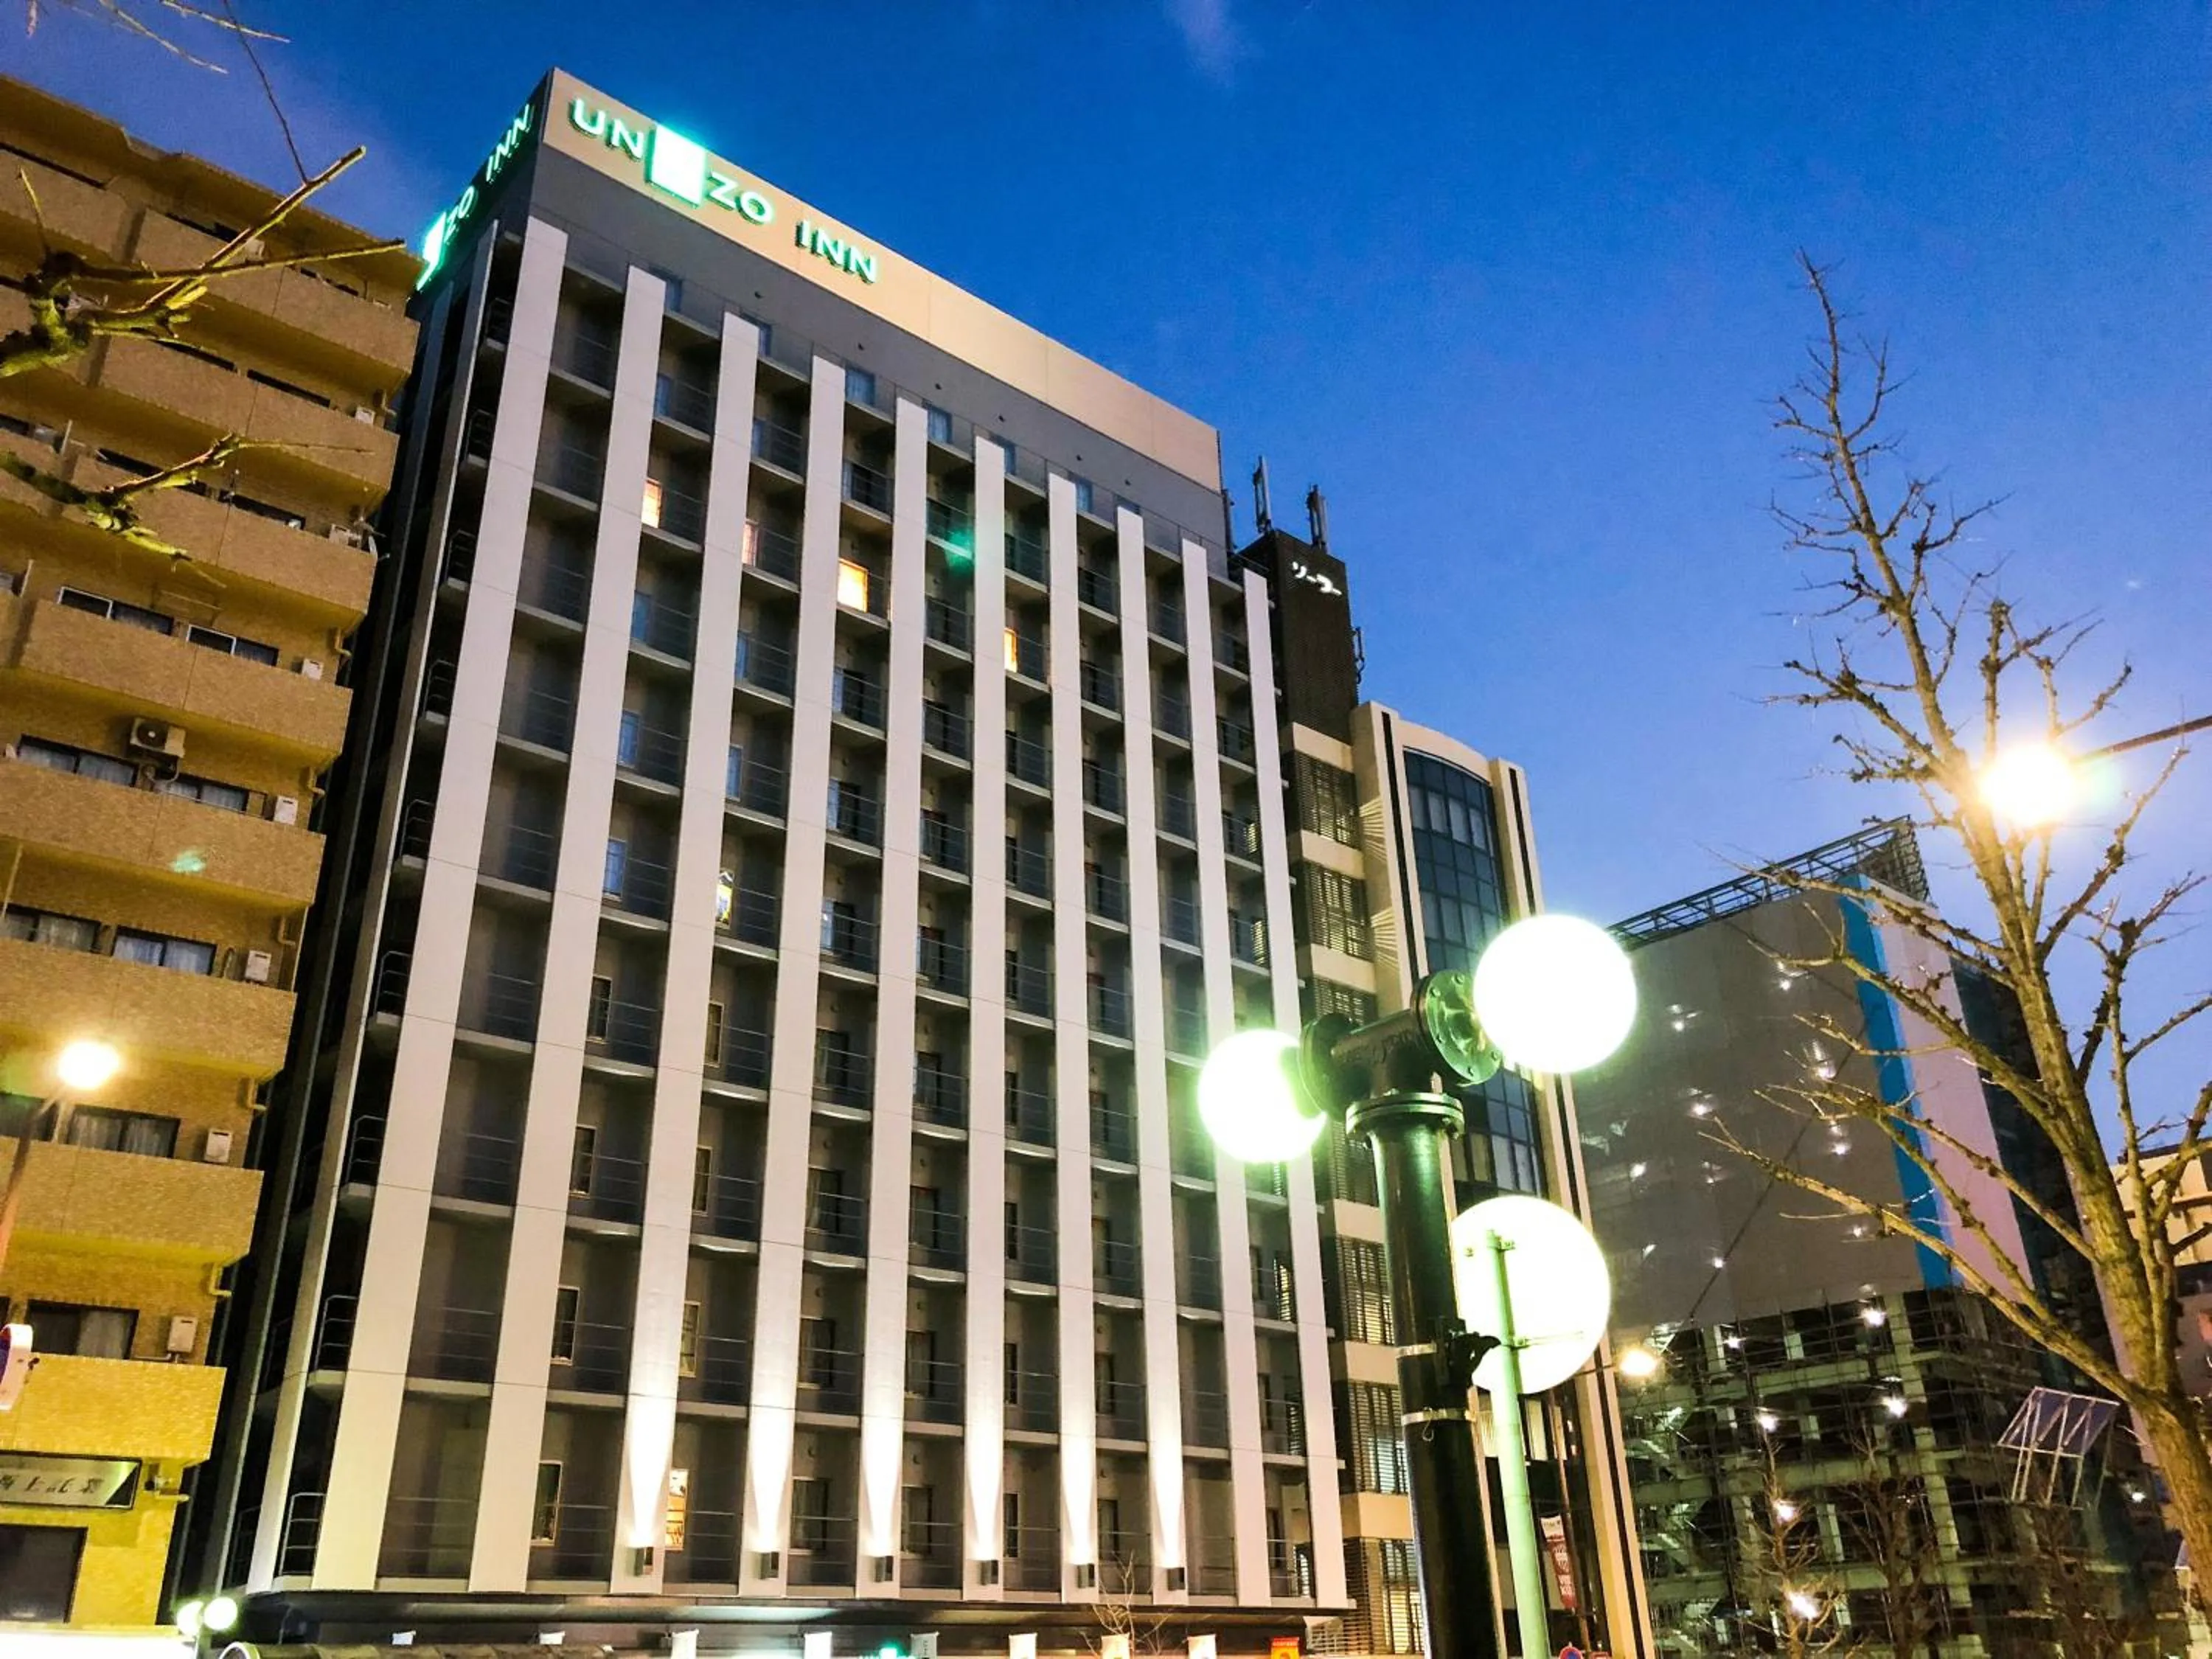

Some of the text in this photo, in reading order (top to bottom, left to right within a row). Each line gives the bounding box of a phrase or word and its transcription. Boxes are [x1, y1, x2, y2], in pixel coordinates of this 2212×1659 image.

[486, 103, 534, 183] INN
[568, 97, 877, 285] UNZO INN
